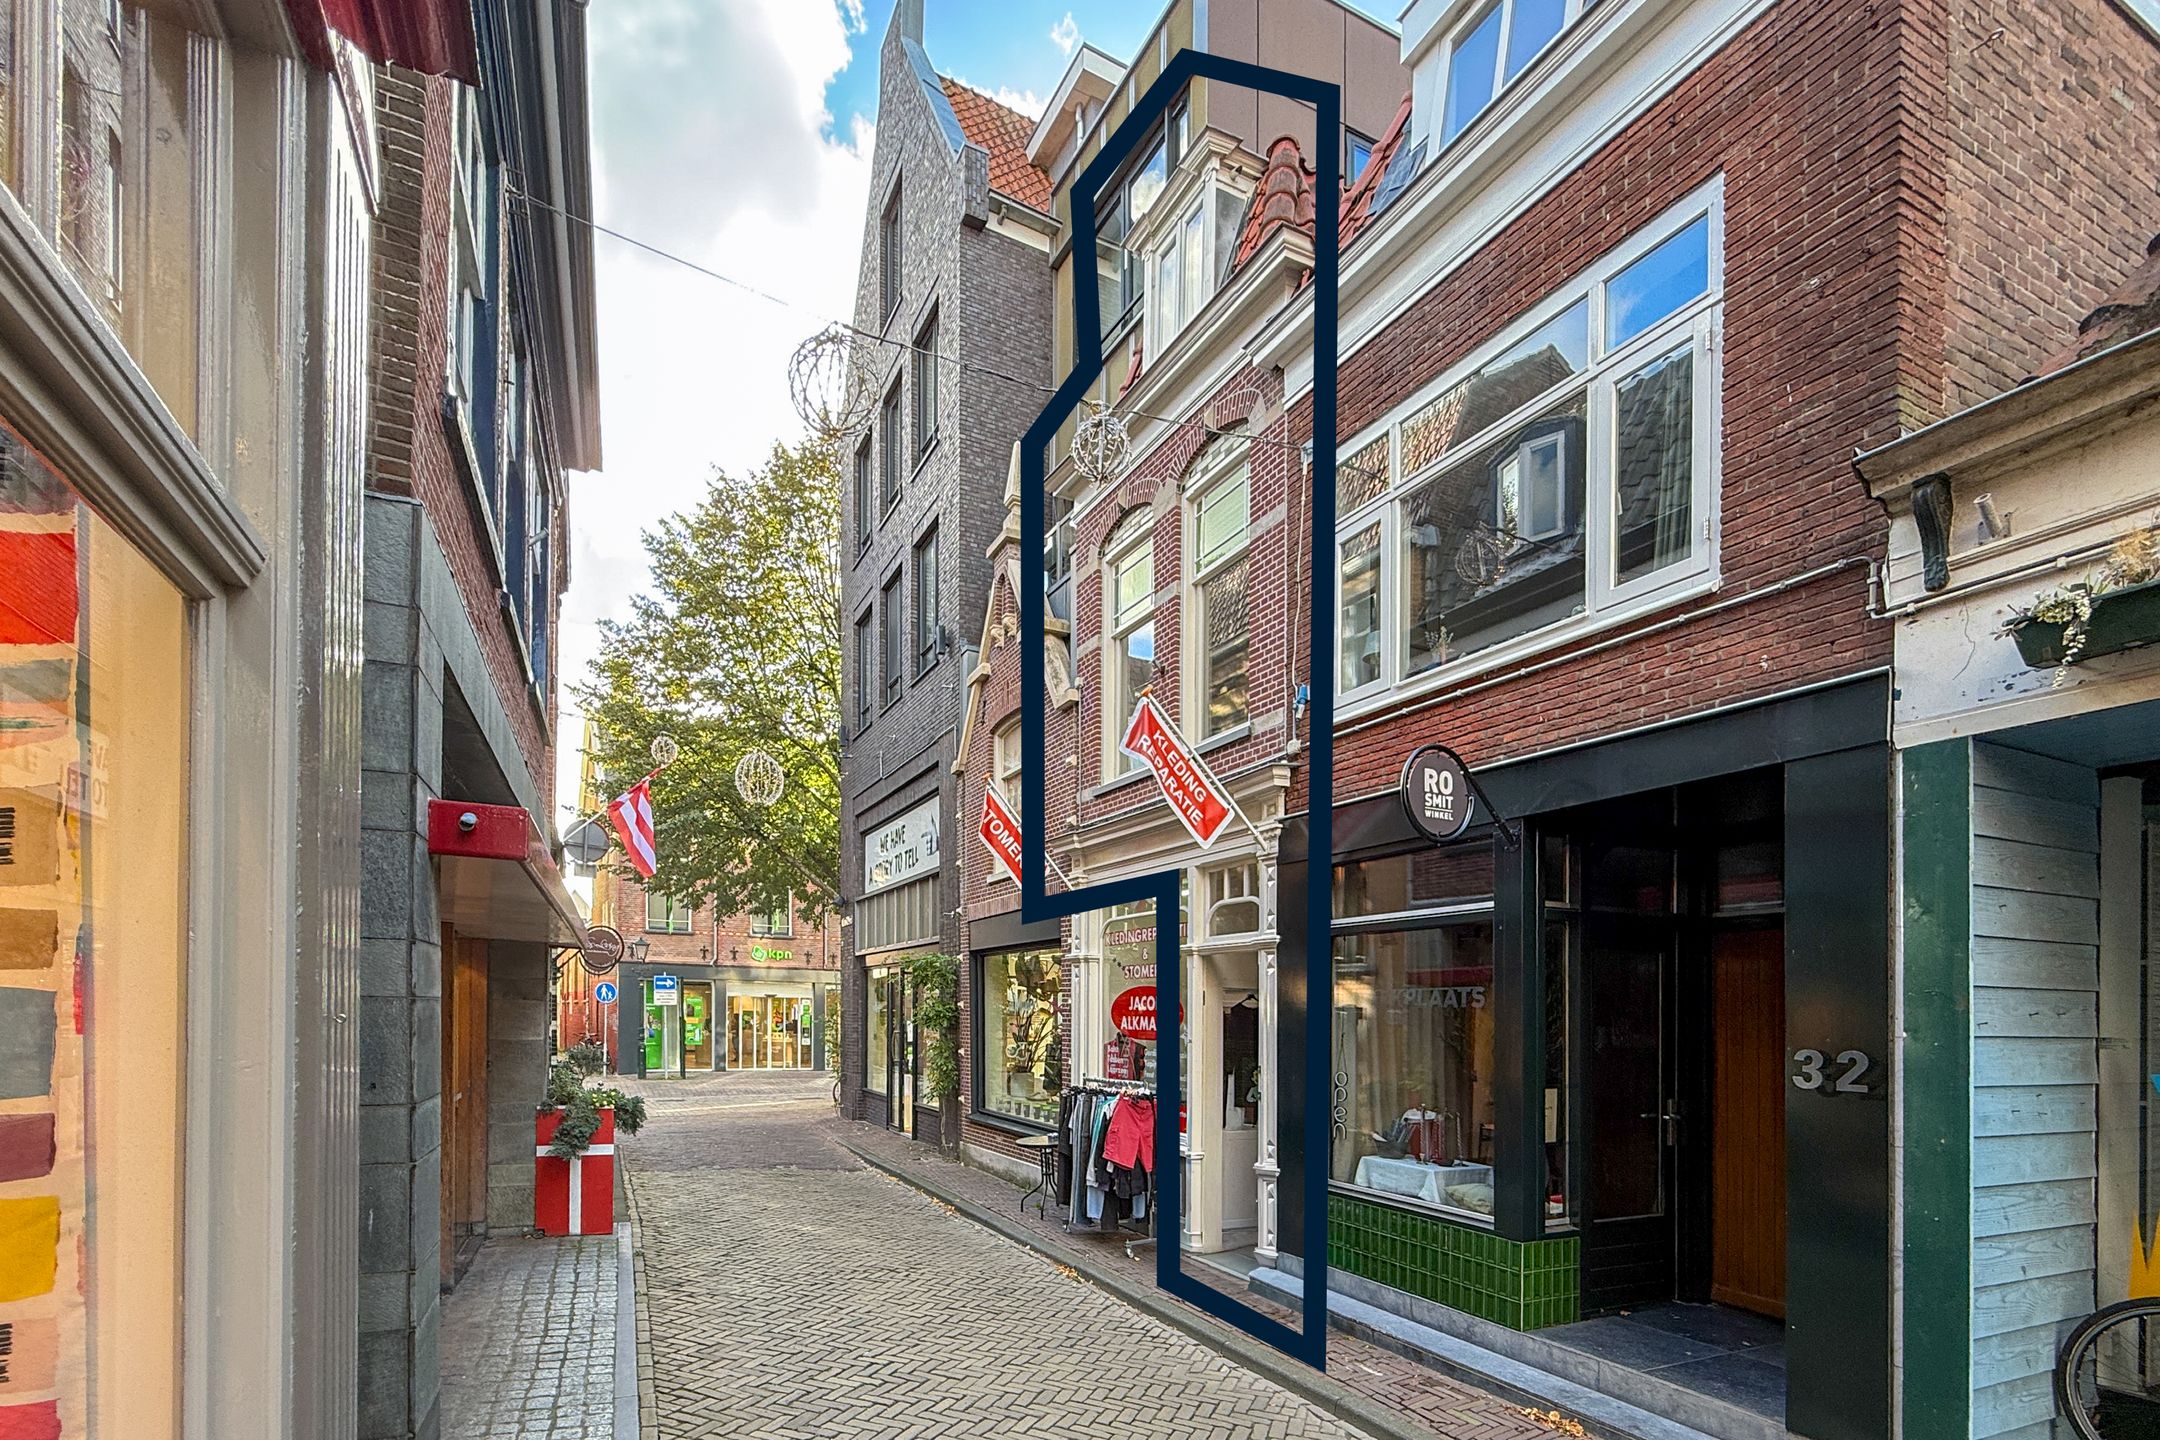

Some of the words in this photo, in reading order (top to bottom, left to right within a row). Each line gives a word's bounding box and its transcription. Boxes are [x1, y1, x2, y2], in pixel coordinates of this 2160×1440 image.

[1152, 729, 1206, 803] KLEDING
[1136, 734, 1204, 826] REPARATIE
[1424, 768, 1453, 795] RO
[1425, 793, 1454, 809] SMIT
[1425, 809, 1454, 821] WINKEL
[879, 833, 889, 853] WE
[890, 824, 906, 849] HAVE
[895, 852, 903, 875] TO
[904, 846, 919, 871] TELL
[768, 948, 793, 961] kpn
[1142, 947, 1149, 960] &
[1129, 995, 1157, 1012] JACO
[1120, 1015, 1157, 1031] ALKMA
[1792, 1049, 1869, 1093] 32
[1333, 1071, 1348, 1140] open
